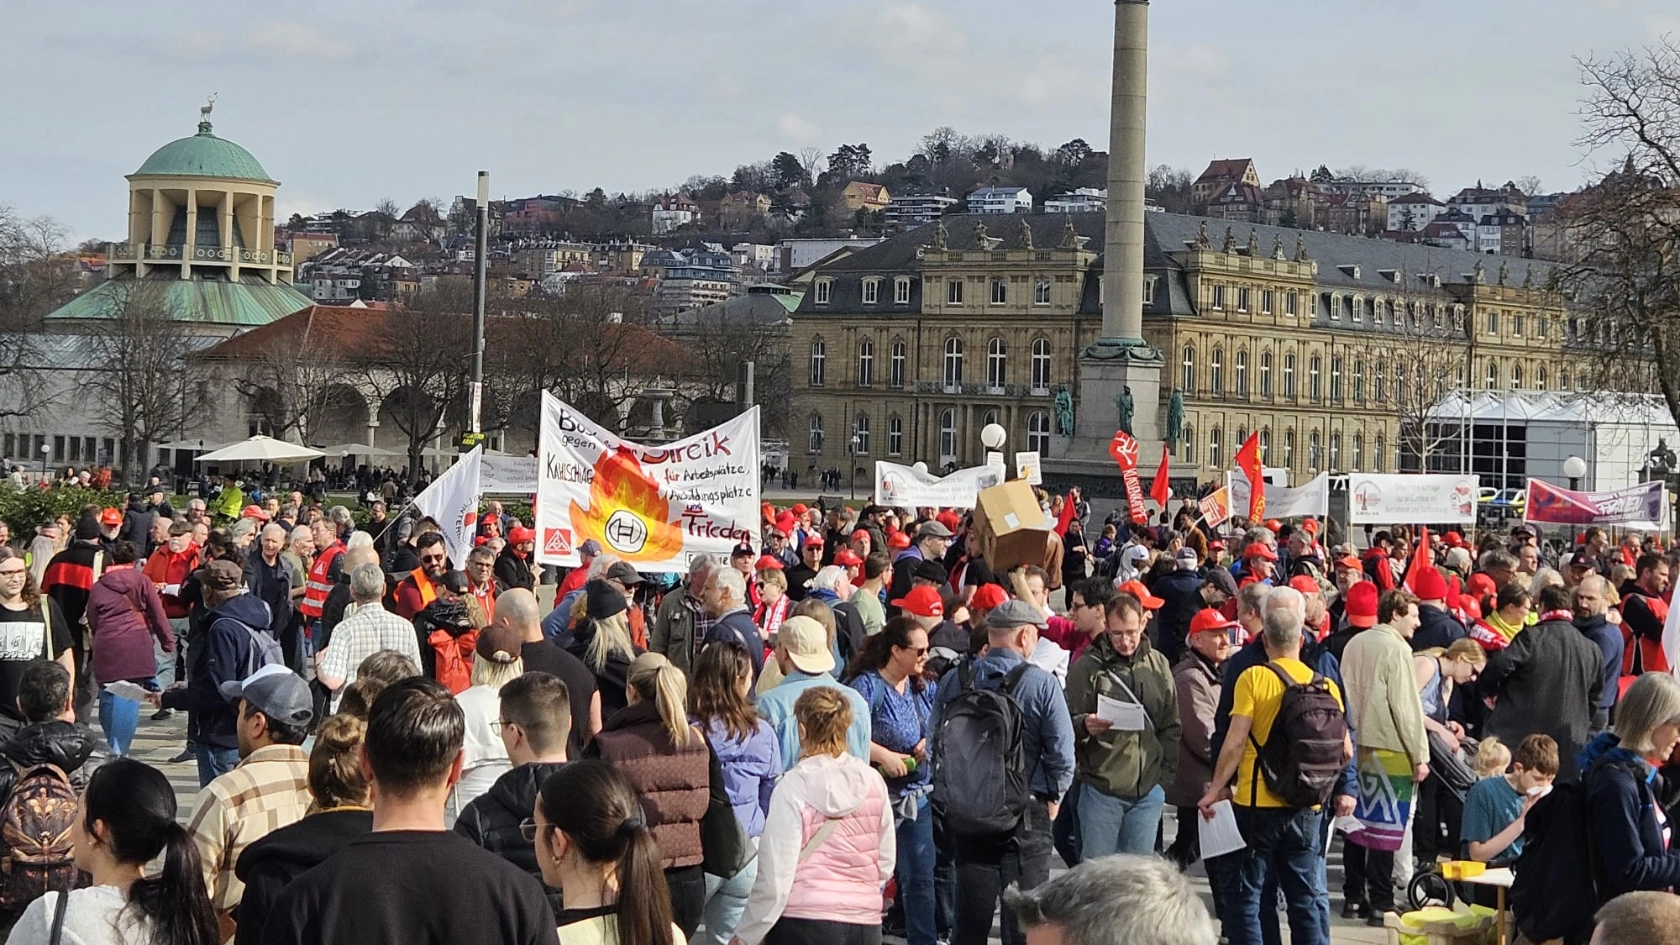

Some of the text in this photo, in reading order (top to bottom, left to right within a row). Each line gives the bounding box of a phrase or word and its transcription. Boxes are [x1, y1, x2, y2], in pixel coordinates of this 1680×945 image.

[562, 434, 596, 450] gegen
[664, 467, 680, 484] für
[682, 513, 750, 540] Frieden
